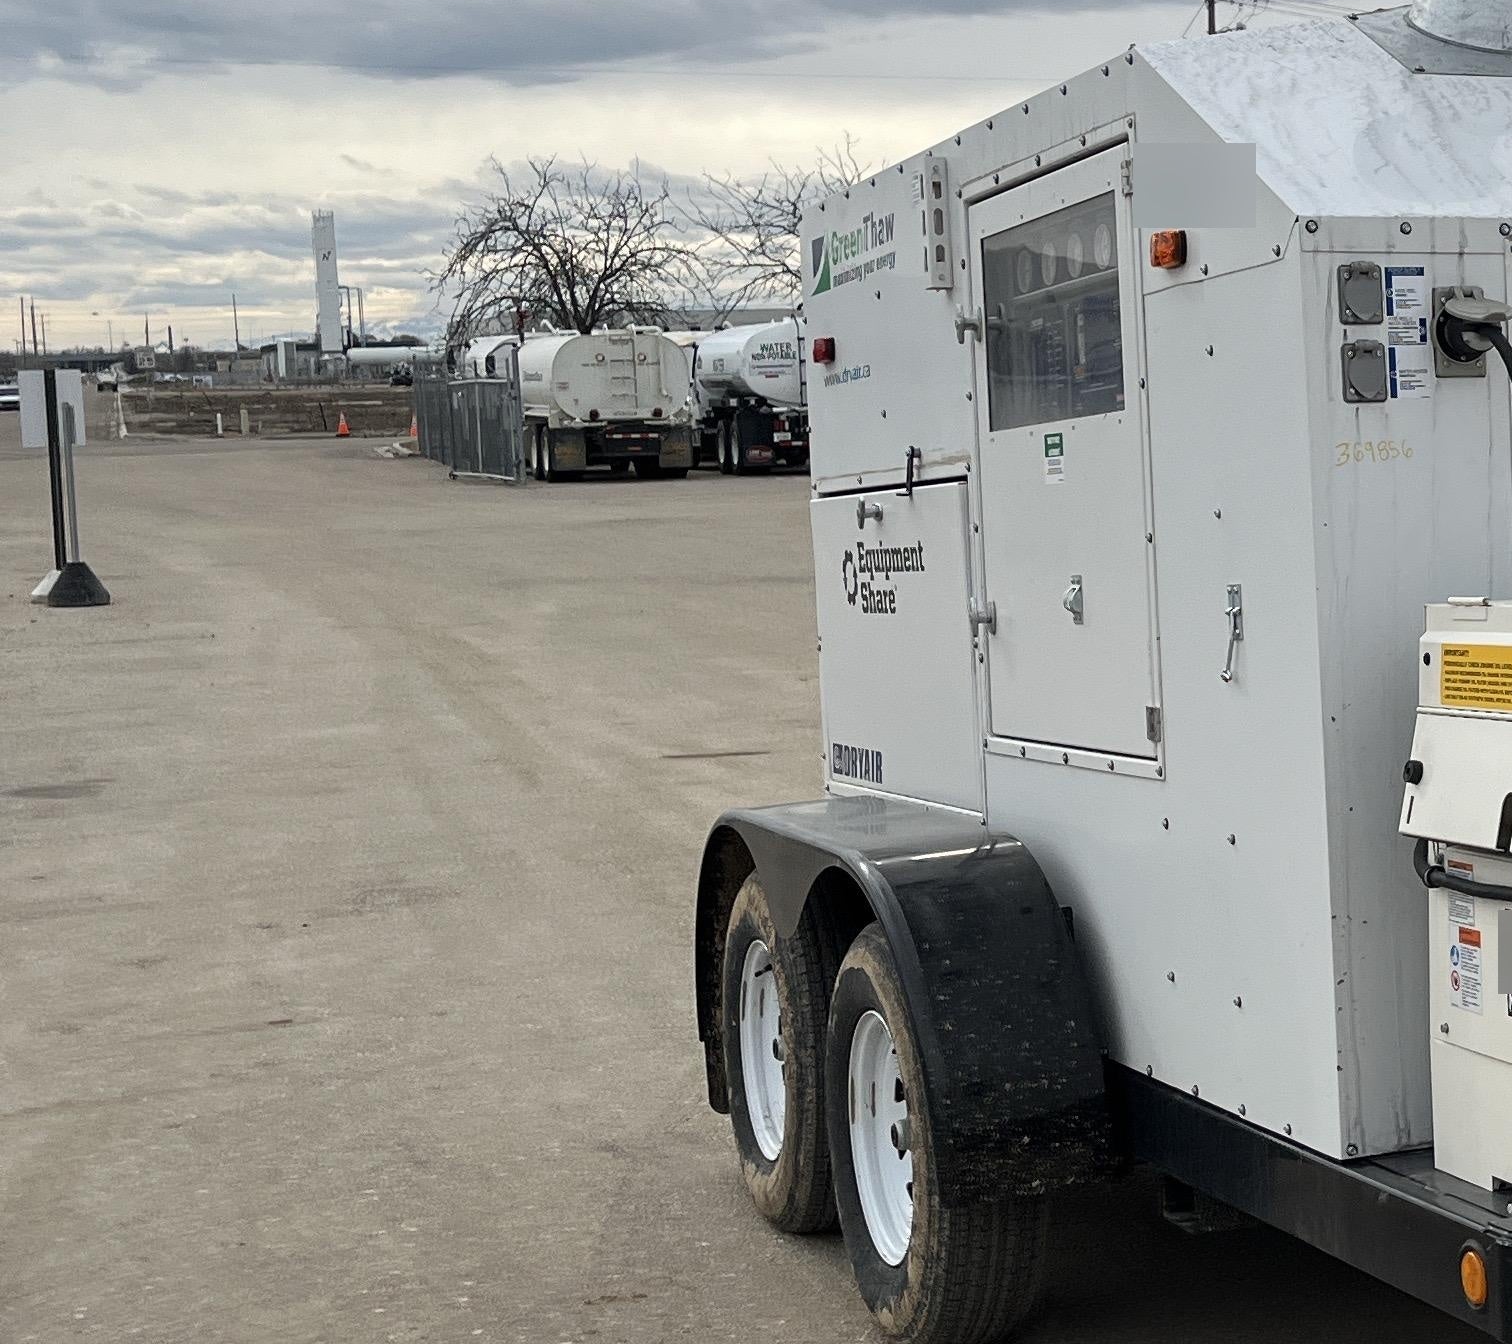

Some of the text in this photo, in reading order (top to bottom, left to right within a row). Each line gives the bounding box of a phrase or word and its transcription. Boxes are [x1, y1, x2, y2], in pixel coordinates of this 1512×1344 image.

[831, 211, 895, 266] GreenThaw
[760, 341, 793, 354] WATER
[1335, 439, 1414, 467] 369856
[856, 540, 925, 581] Equipment
[860, 581, 898, 615] Share
